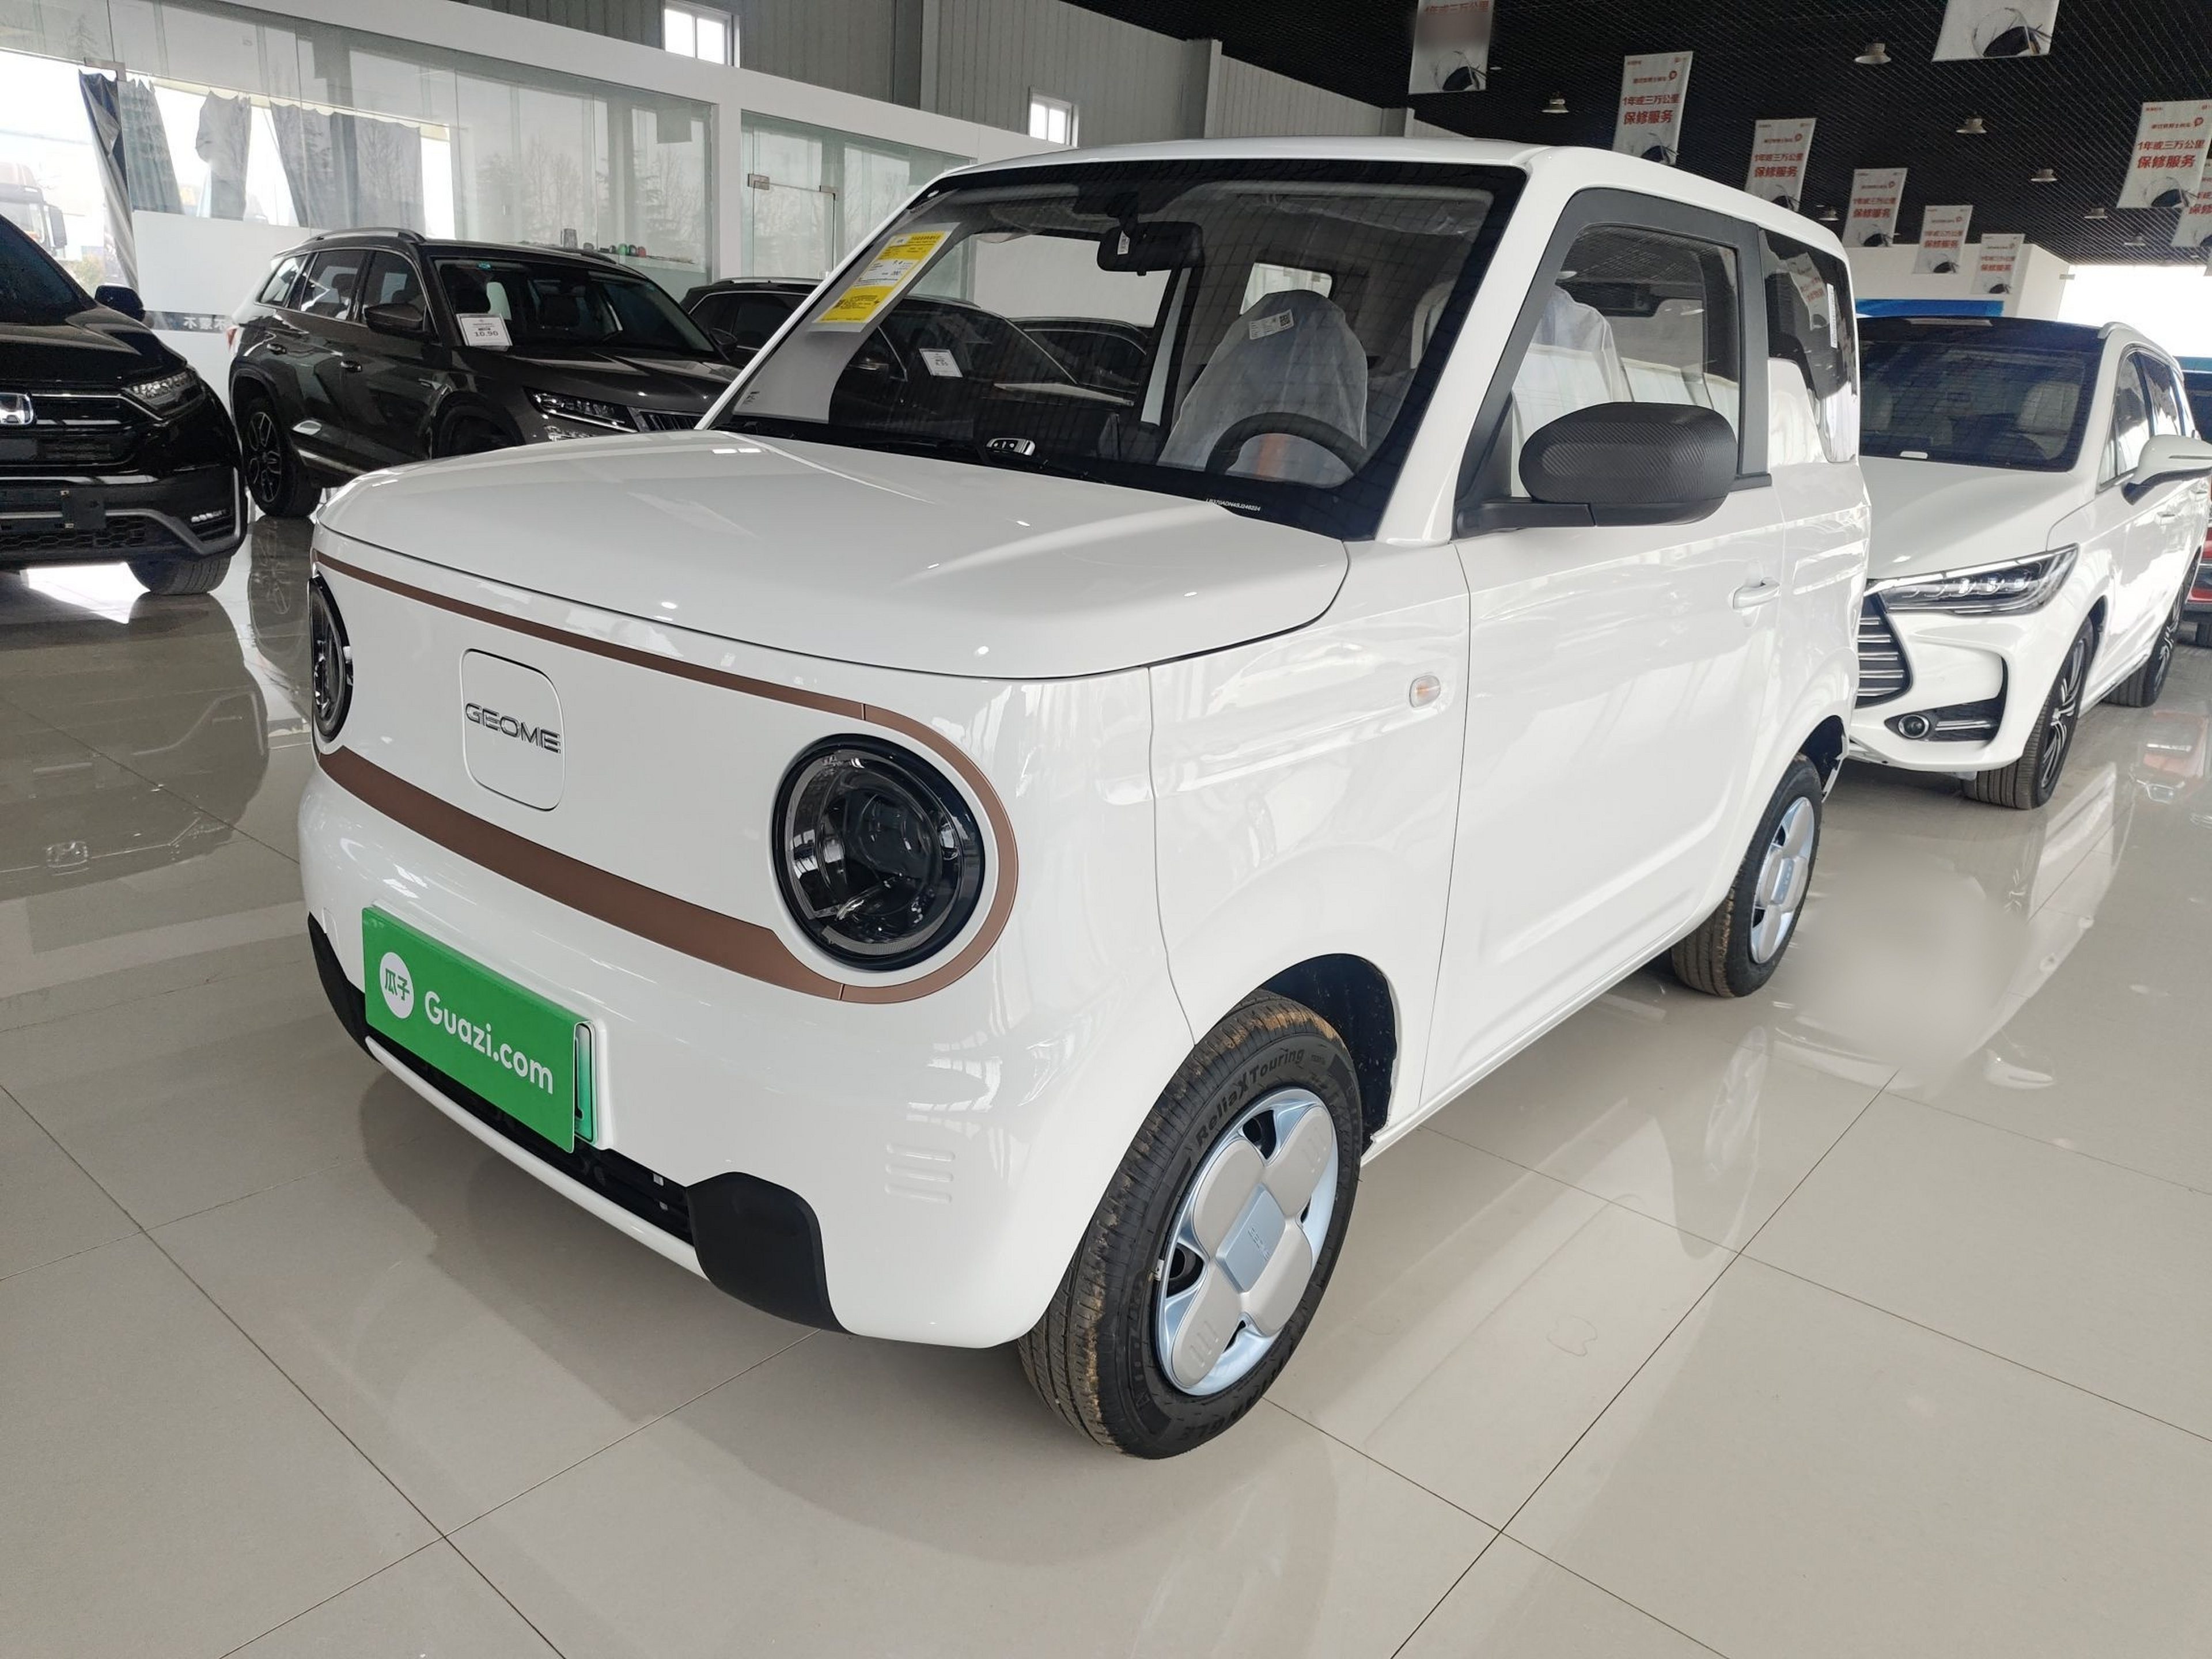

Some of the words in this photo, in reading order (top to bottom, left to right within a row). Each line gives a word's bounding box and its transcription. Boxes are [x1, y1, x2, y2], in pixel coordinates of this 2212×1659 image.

[1623, 93, 1680, 105] 1年或三万公里
[1623, 109, 1674, 124] 保修服务
[2138, 139, 2205, 150] 1年或三万公里
[2137, 154, 2196, 169] 保修服务
[1754, 166, 1798, 177] 保修服务
[465, 702, 561, 754] GEOME
[385, 968, 410, 1001] 瓜子
[425, 990, 554, 1095] Guazi.com
[1250, 1048, 1305, 1084] Touring
